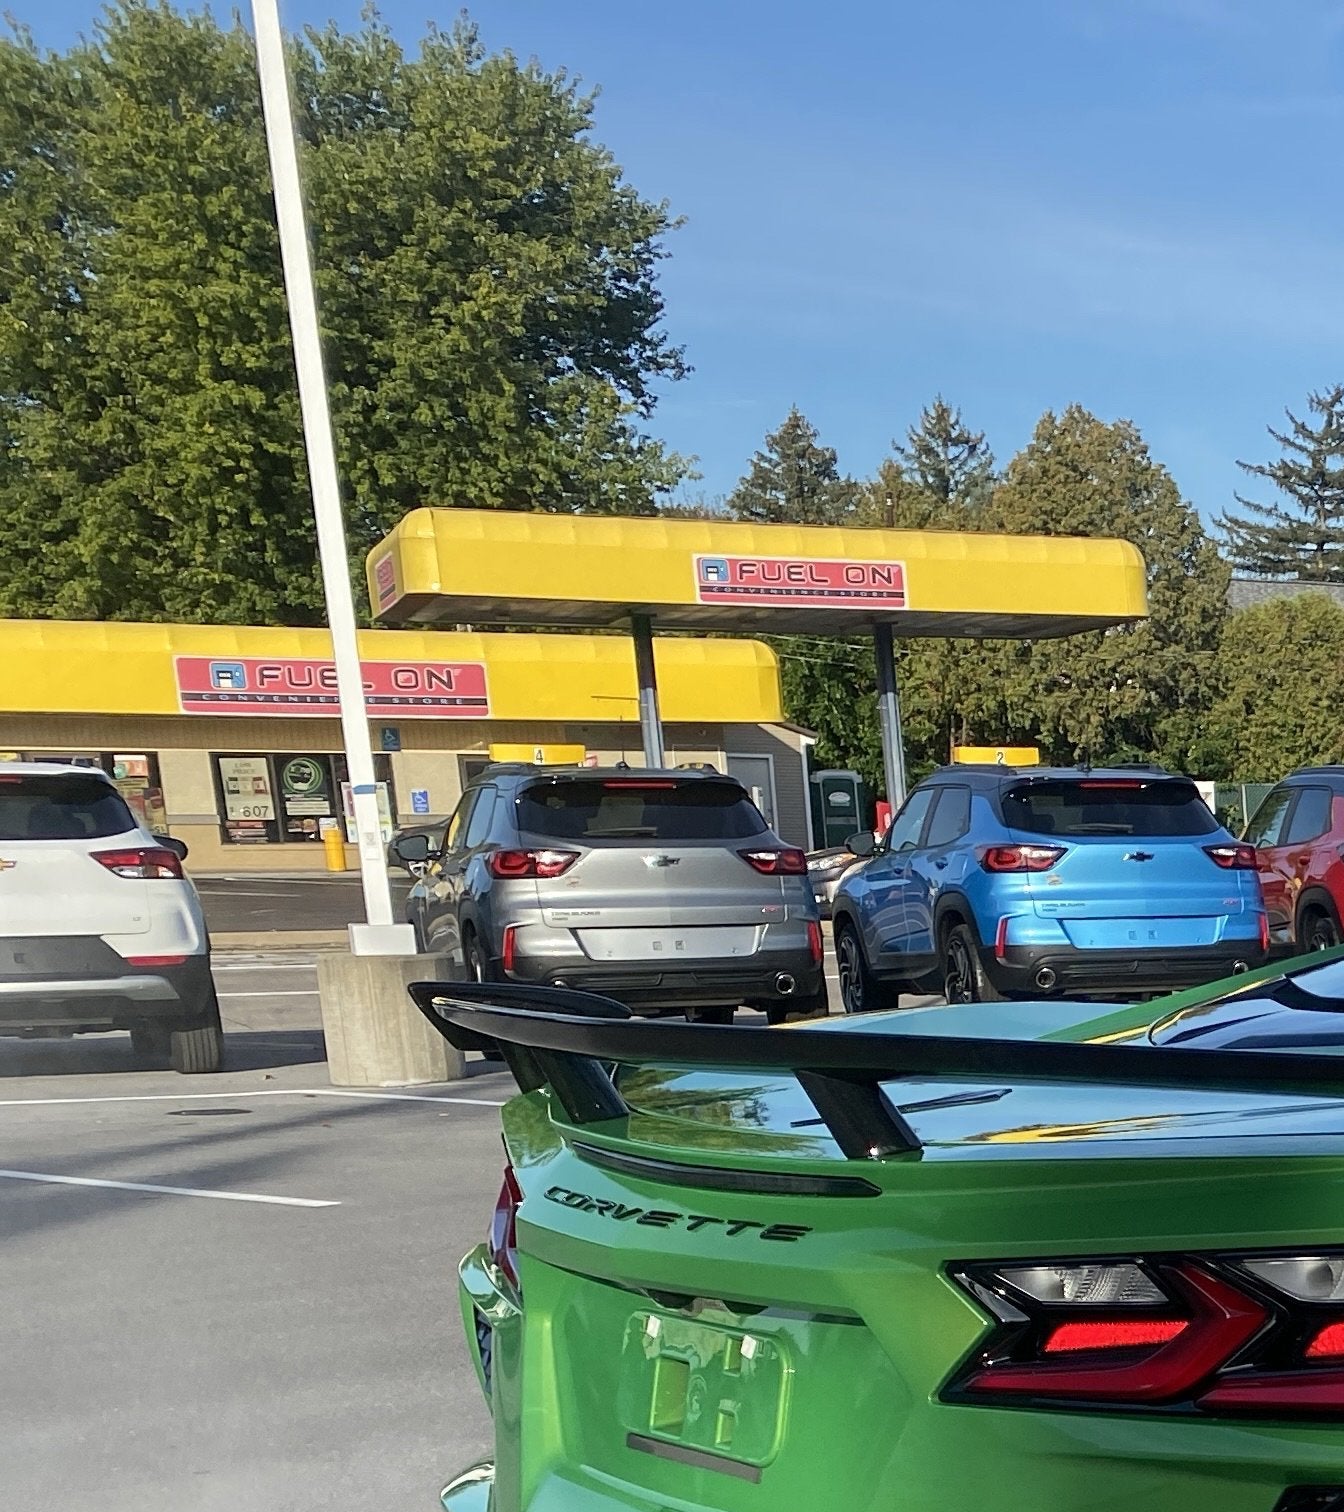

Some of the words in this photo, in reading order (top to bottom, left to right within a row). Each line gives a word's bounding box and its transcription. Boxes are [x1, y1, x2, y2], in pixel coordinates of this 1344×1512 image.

[738, 562, 829, 584] FUEL
[845, 565, 892, 585] ON
[257, 664, 373, 690] FUE
[393, 668, 454, 690] ON
[201, 692, 376, 705] CONVENIENE
[391, 695, 464, 705] STORE
[534, 749, 543, 764] 4
[543, 1185, 814, 1242] CORVETTE
